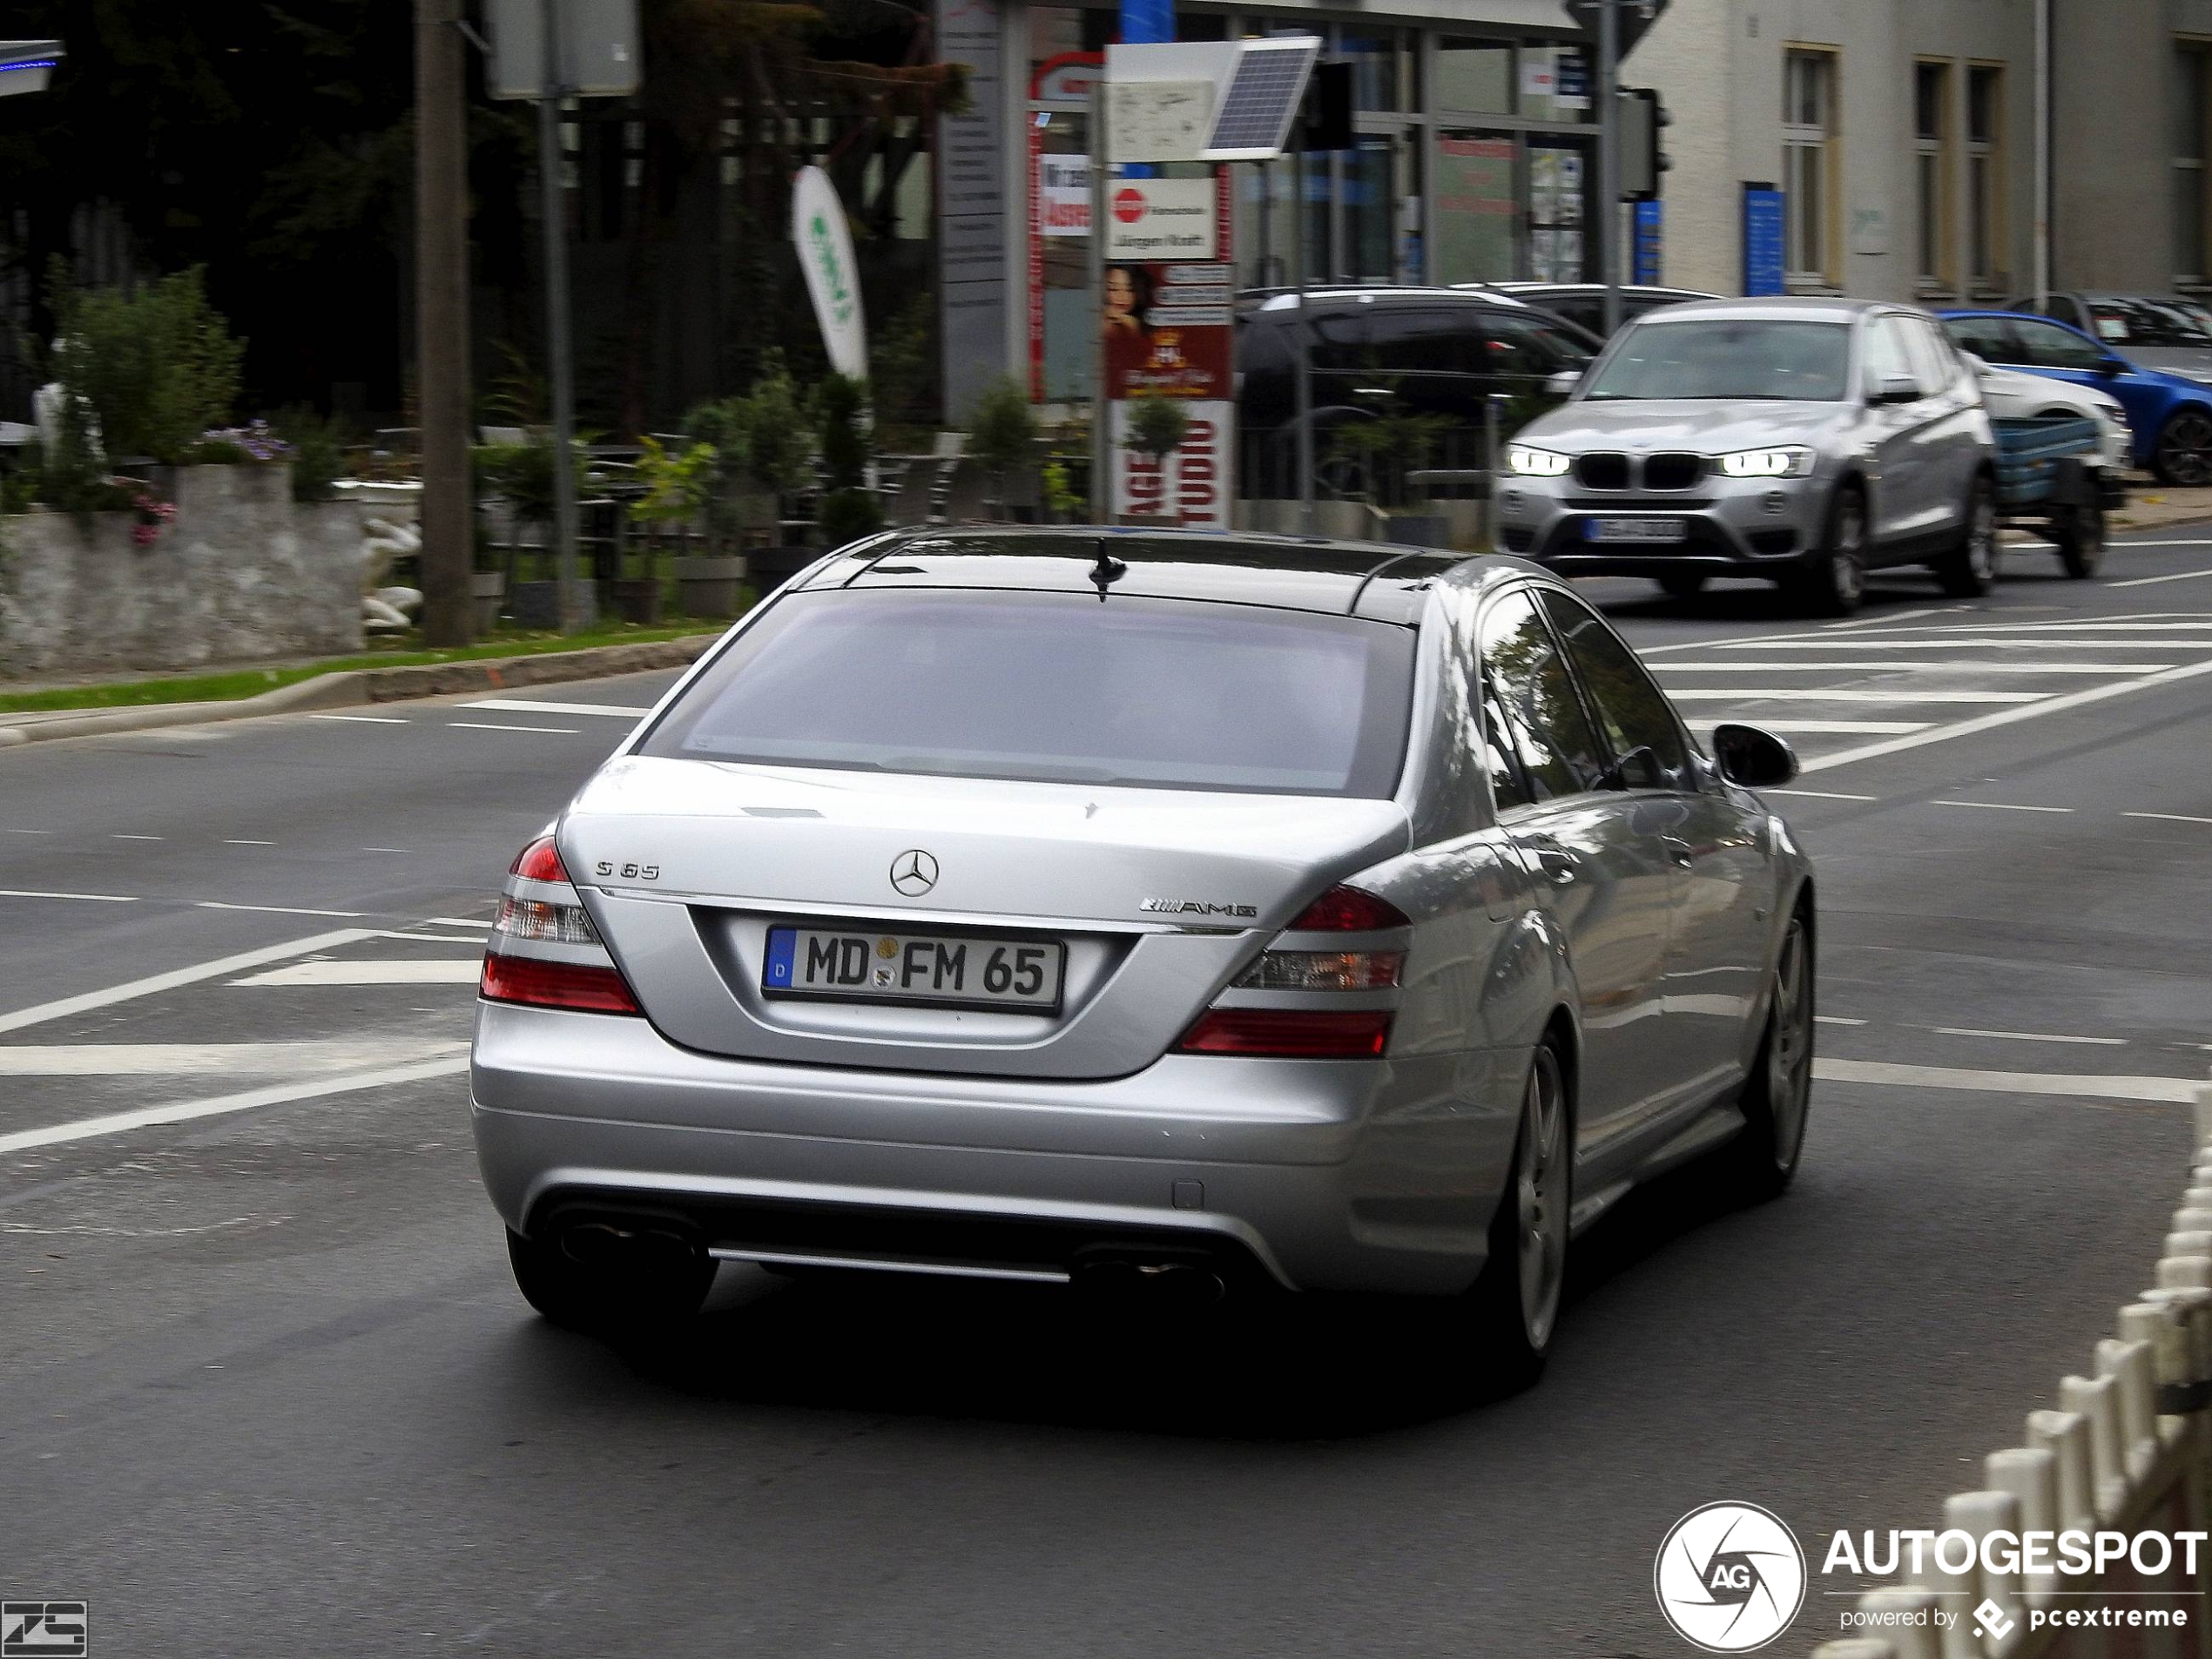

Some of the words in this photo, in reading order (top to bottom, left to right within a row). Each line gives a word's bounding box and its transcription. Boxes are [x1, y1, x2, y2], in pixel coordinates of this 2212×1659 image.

[596, 860, 614, 877] S
[619, 862, 660, 880] 65
[1177, 900, 1258, 918] AMG
[806, 935, 870, 986] MD
[900, 941, 967, 991] FM
[983, 947, 1046, 996] 65
